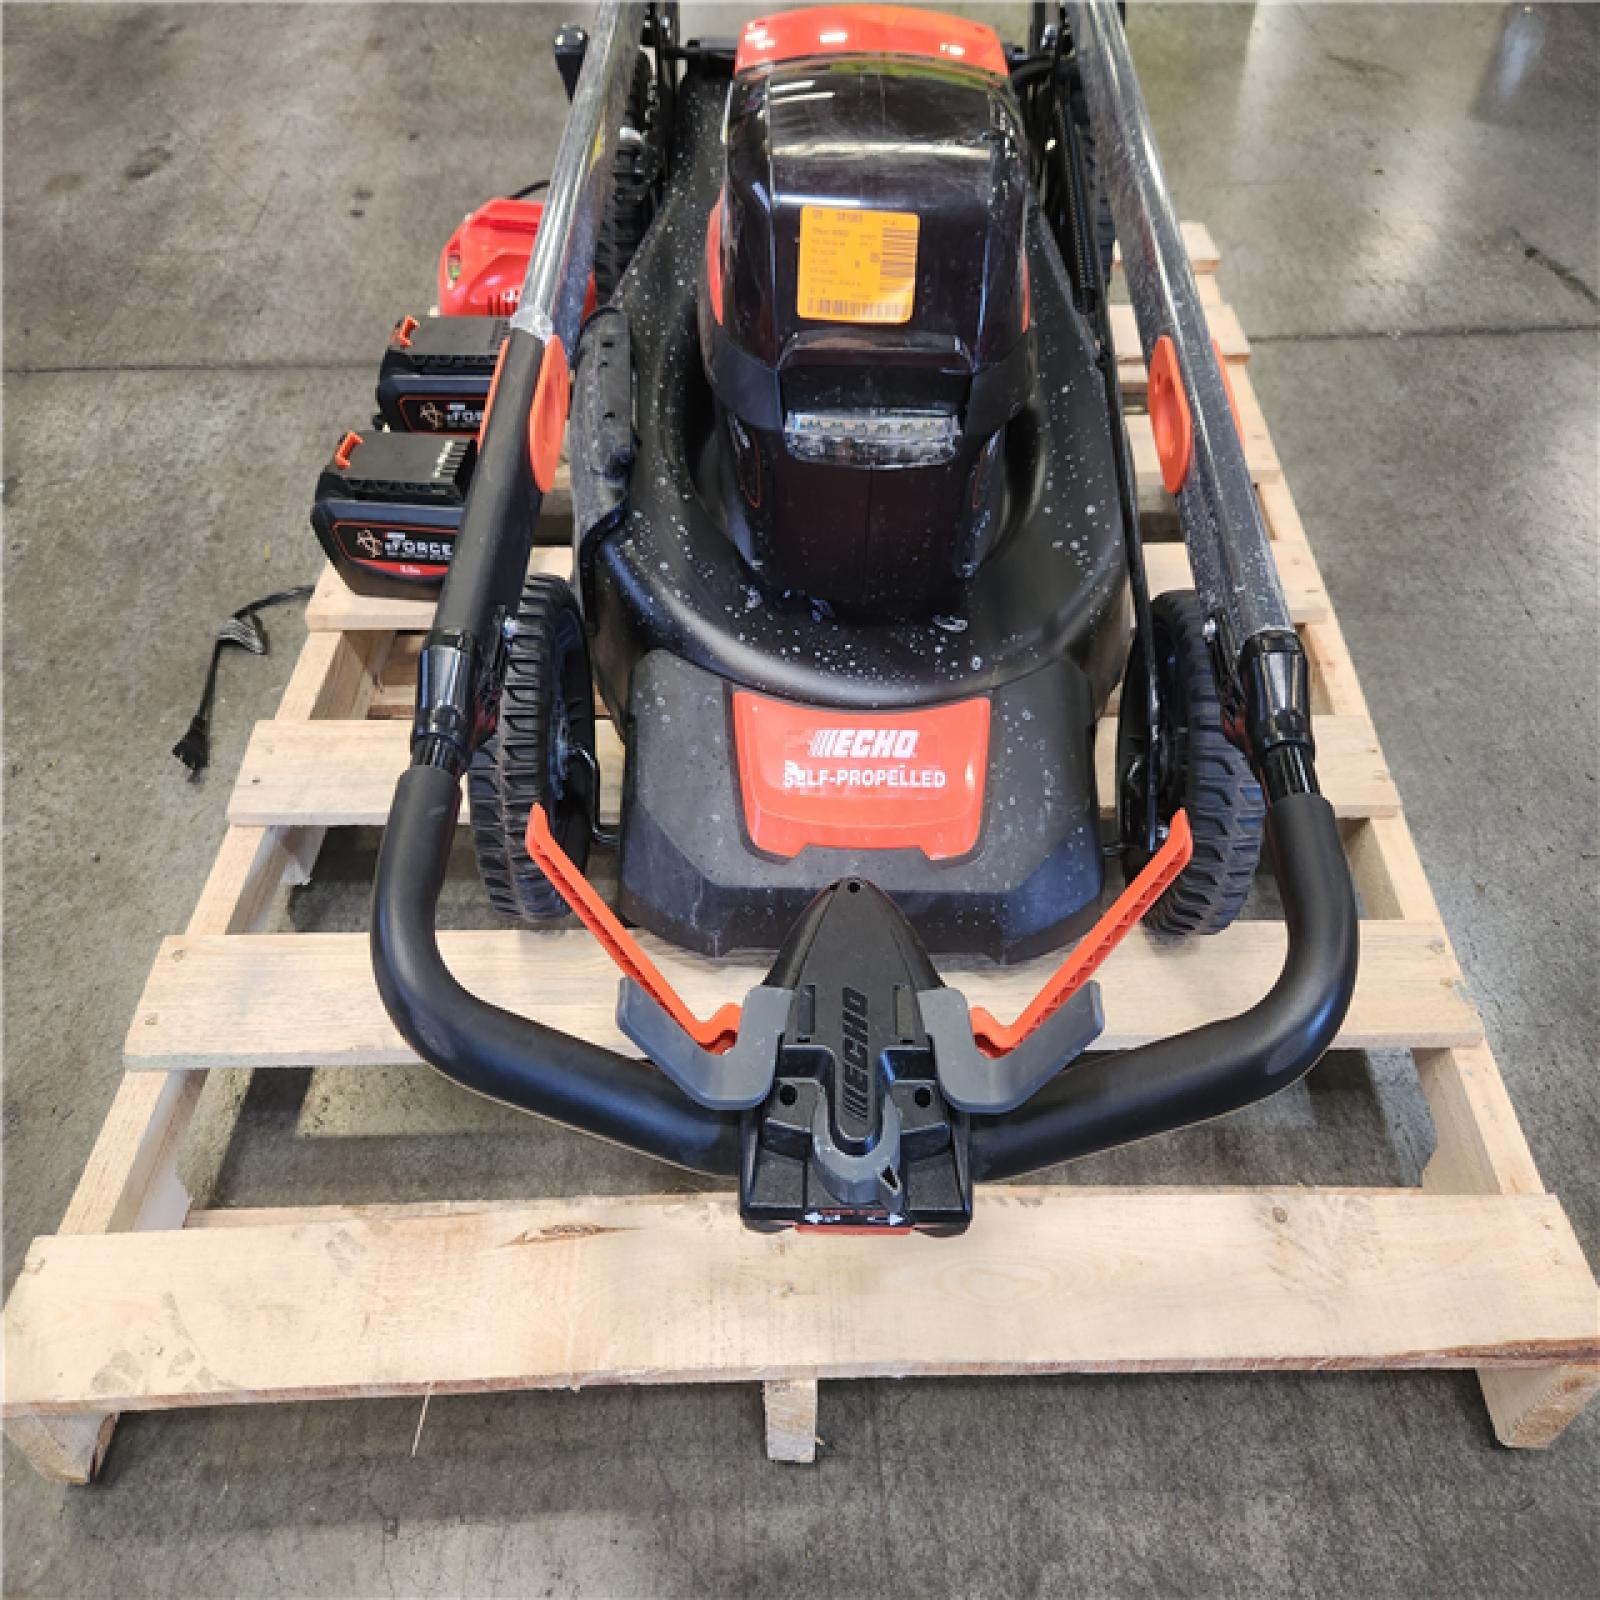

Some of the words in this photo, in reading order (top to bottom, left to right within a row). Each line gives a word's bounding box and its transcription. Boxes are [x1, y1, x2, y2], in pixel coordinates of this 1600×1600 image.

[829, 729, 919, 758] ECHO
[783, 767, 946, 788] SELF-PROPELLED
[843, 986, 869, 1101] ECHO
